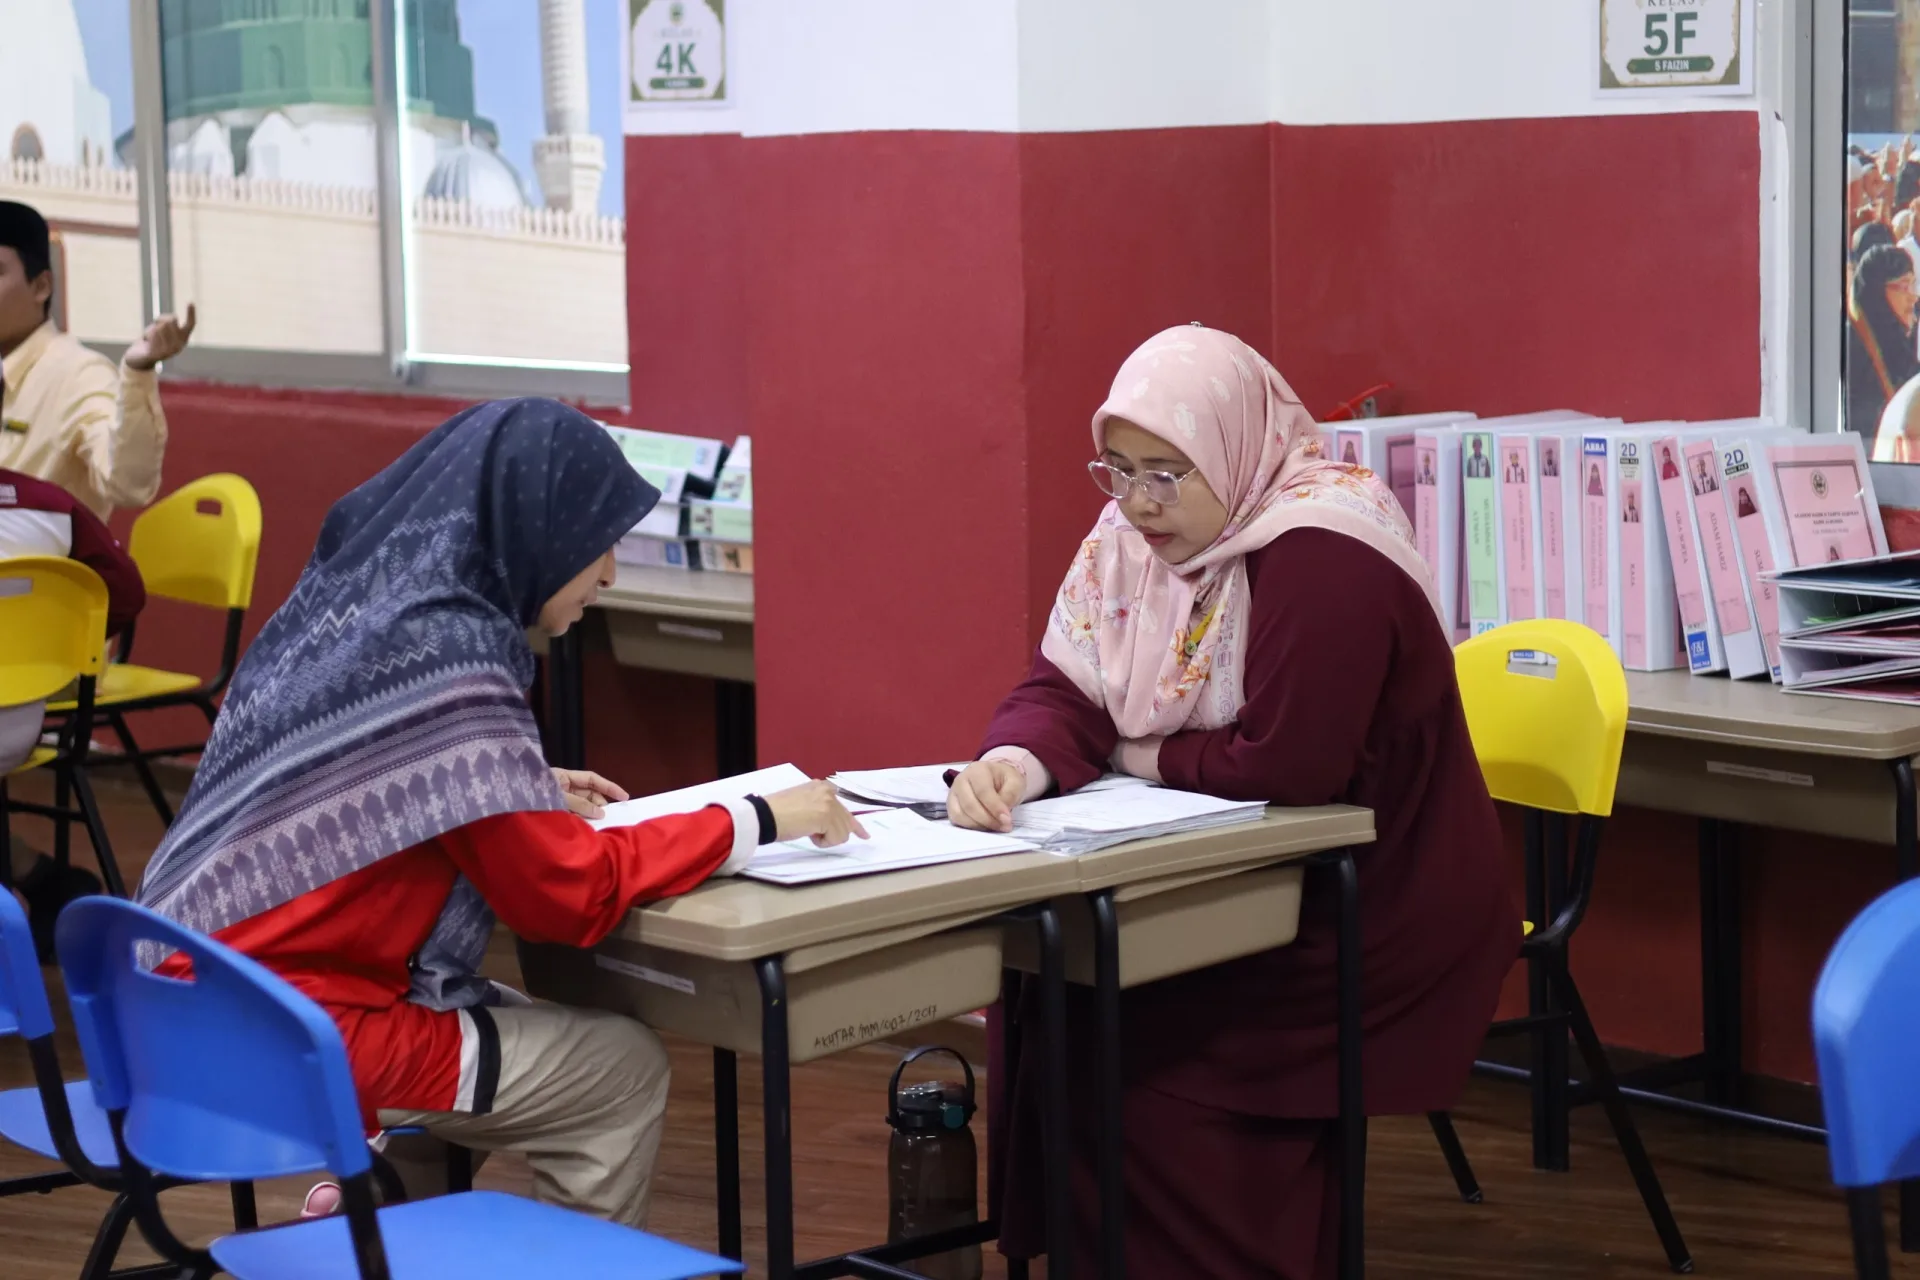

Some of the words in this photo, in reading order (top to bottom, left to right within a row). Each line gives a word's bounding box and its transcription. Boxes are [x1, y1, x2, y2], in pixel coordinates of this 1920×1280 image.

[1643, 12, 1698, 56] 5F
[656, 42, 697, 74] 4K
[1621, 442, 1637, 457] 2D
[1724, 449, 1744, 467] 2D
